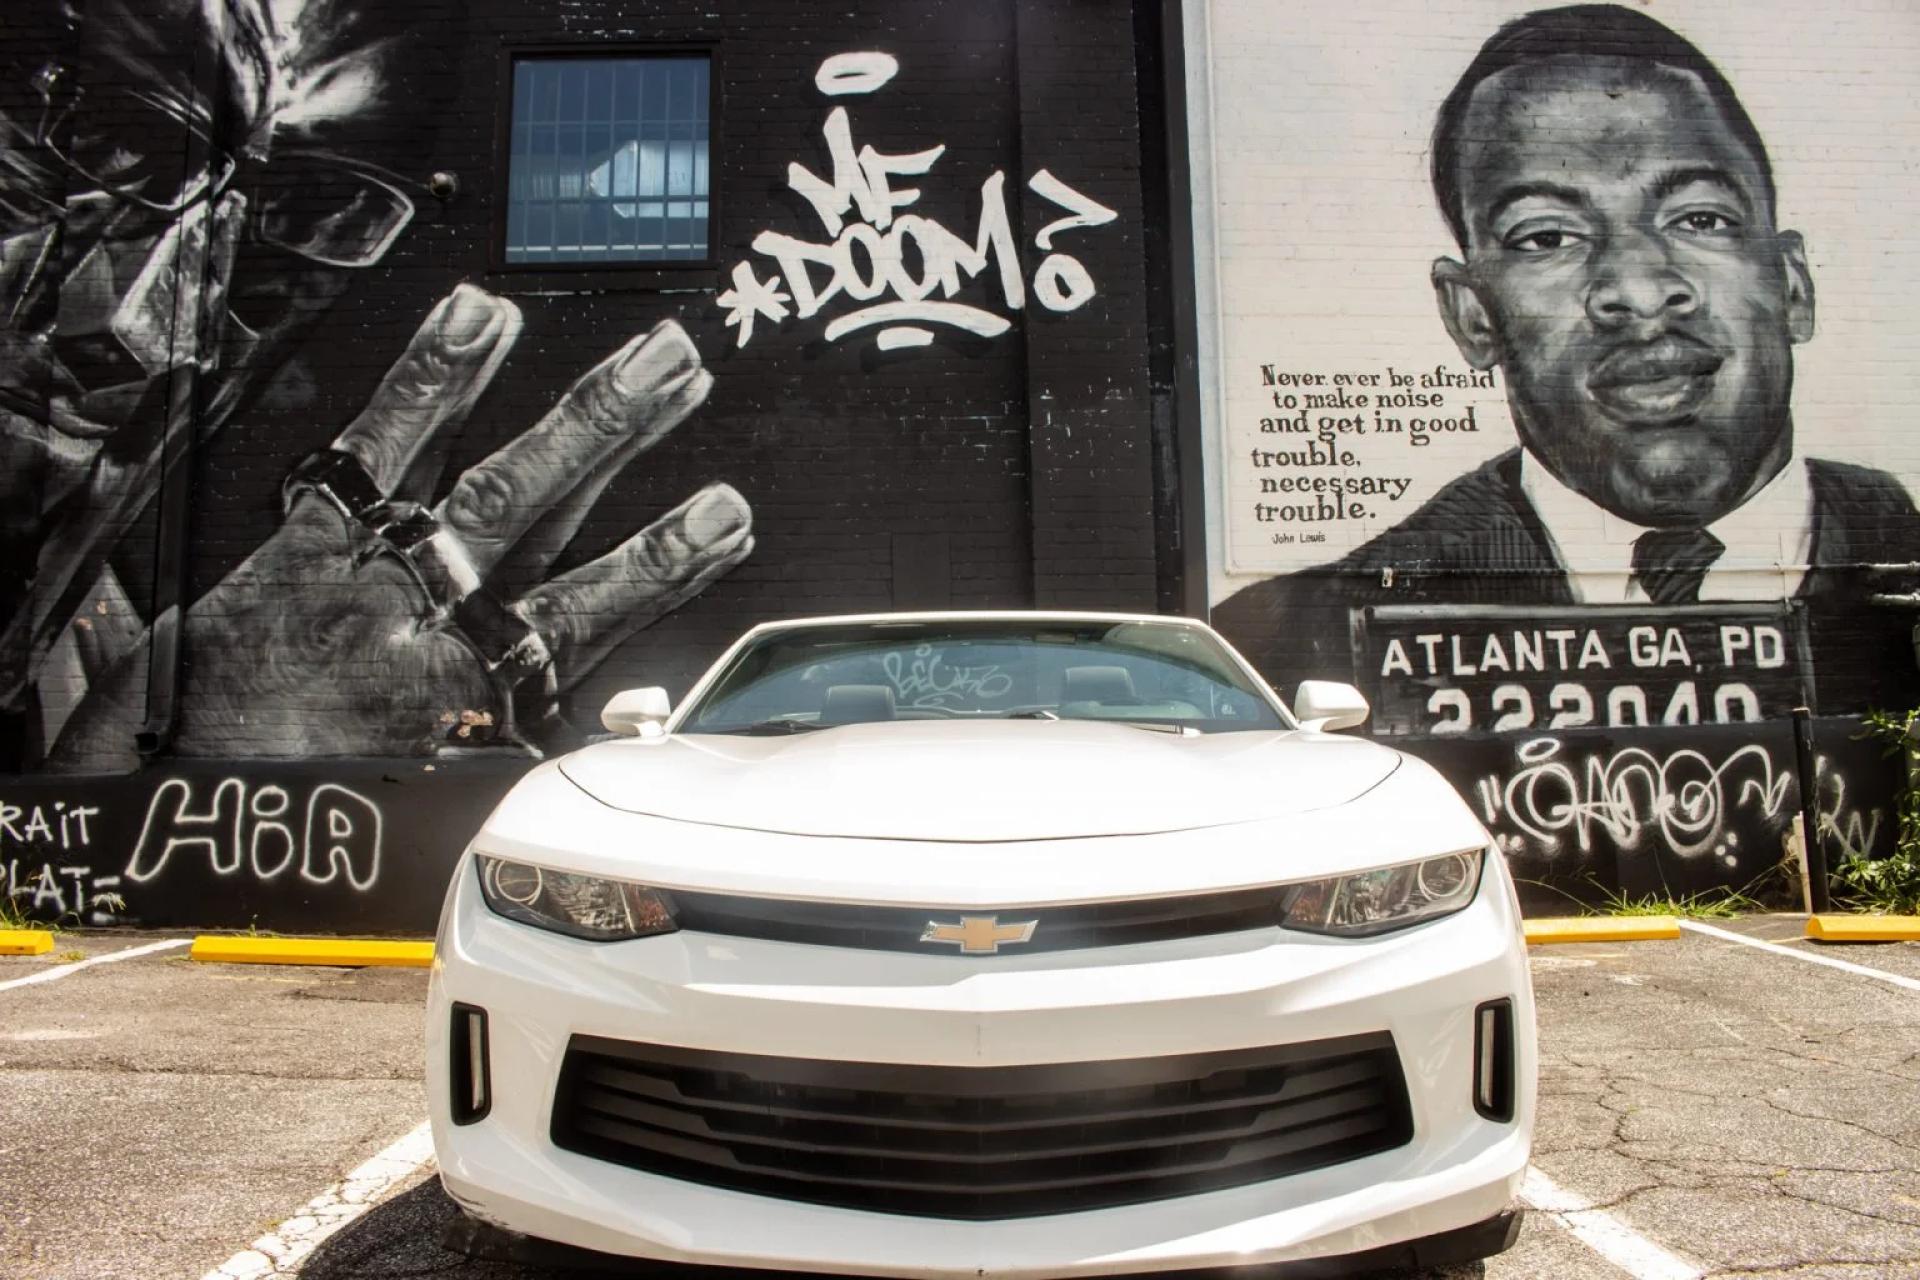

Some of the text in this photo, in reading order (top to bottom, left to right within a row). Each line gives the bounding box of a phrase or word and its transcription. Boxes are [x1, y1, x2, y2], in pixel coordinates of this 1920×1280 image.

[788, 105, 945, 238] MF
[1260, 364, 1495, 389] Never ever be afraid
[1273, 387, 1444, 409] to make noise
[1259, 406, 1480, 446] and get in good
[1259, 476, 1412, 501] necessary
[1254, 494, 1376, 522] trouble.
[1271, 531, 1326, 544] John Lewis
[1381, 629, 1611, 676] ATLANTA
[1719, 625, 1785, 669] PD
